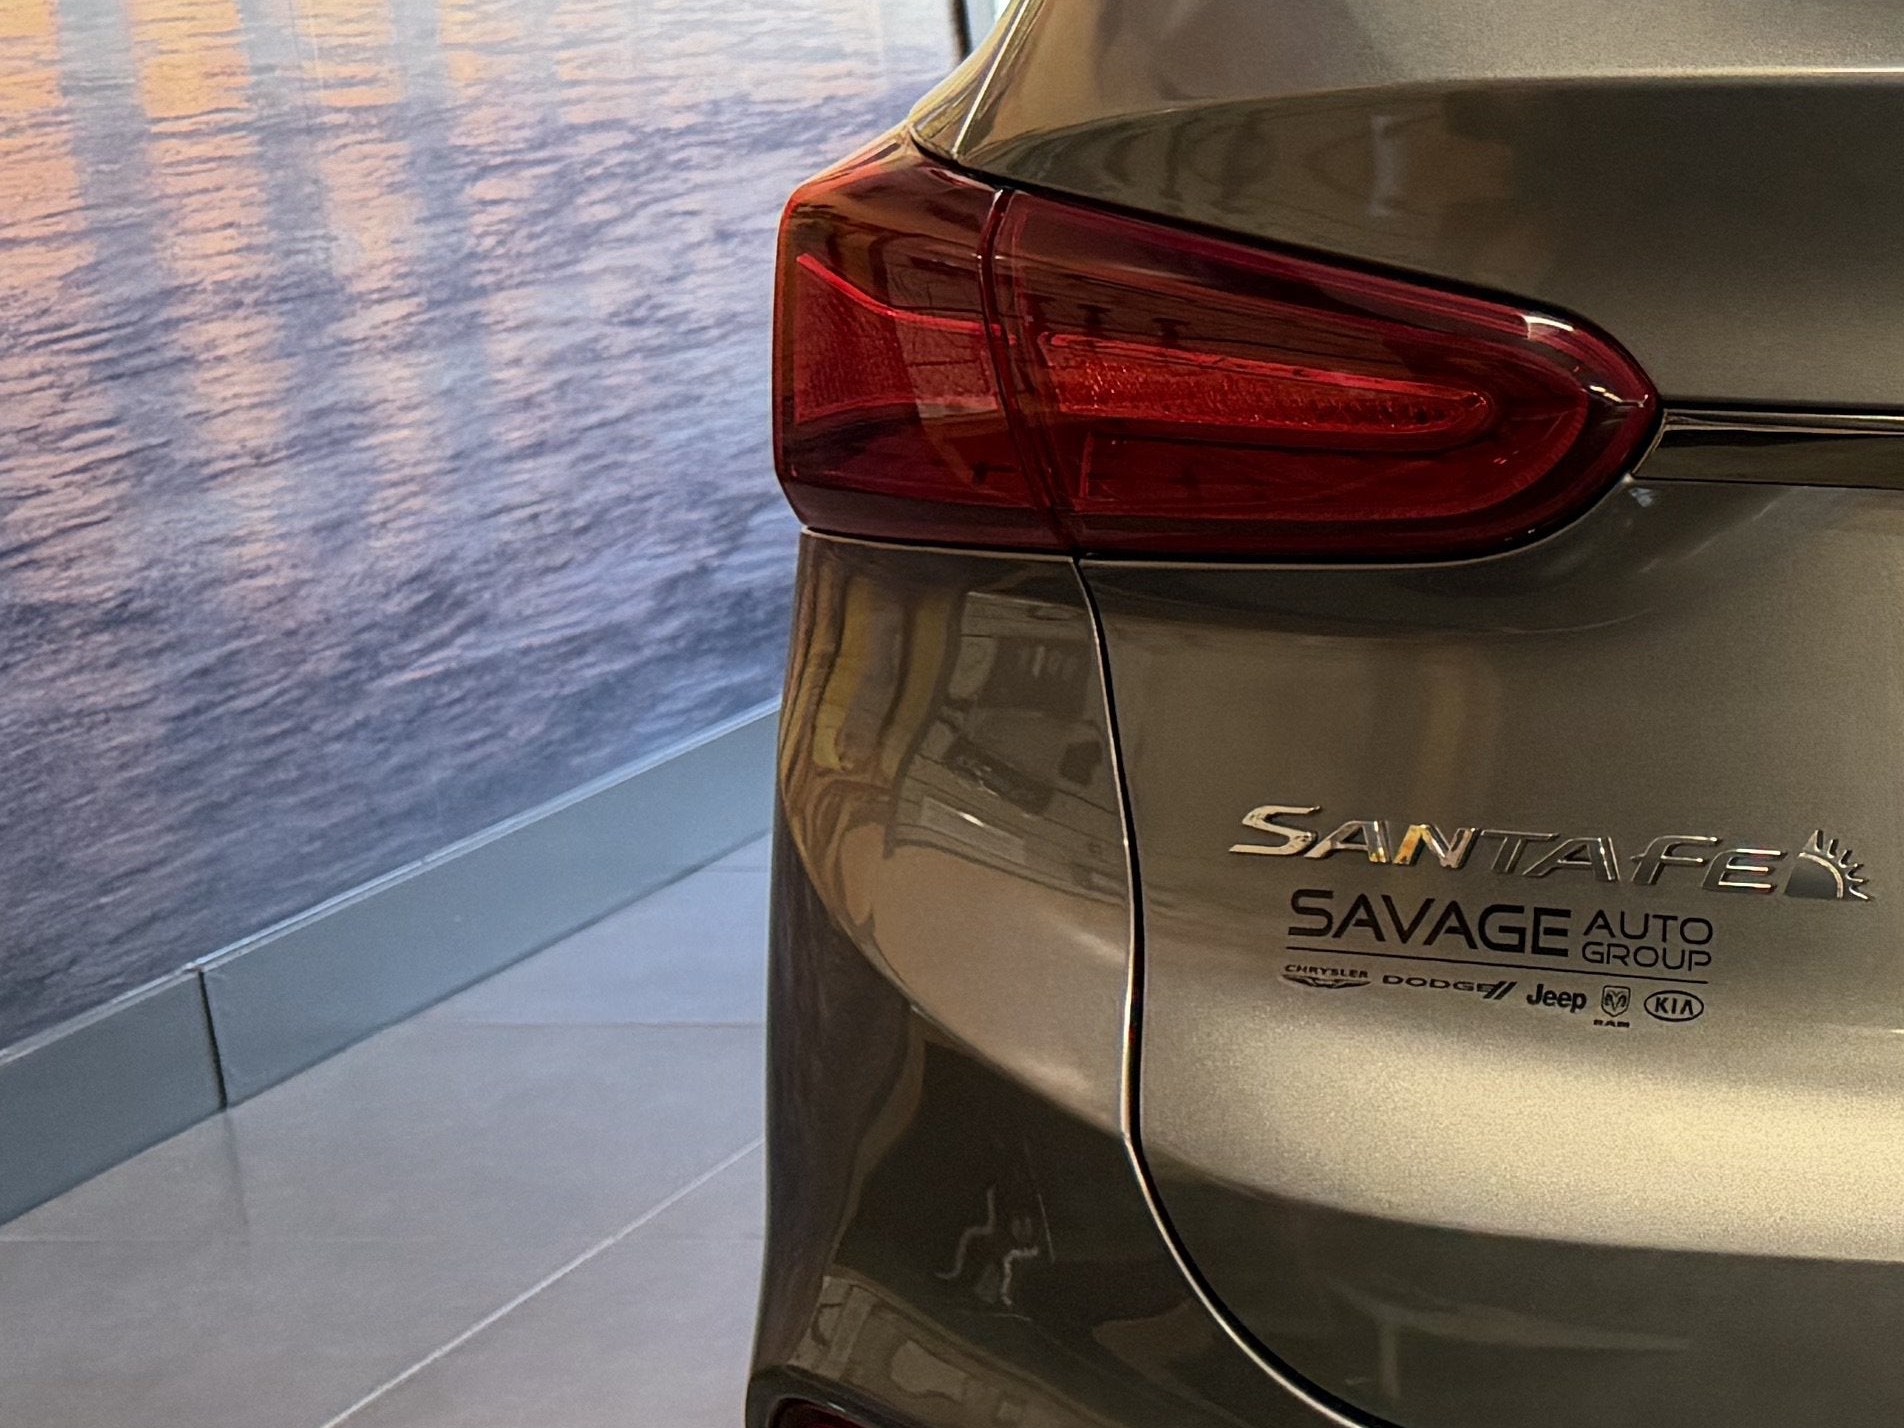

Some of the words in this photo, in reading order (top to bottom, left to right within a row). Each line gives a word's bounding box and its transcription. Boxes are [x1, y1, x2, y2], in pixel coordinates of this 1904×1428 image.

[1288, 888, 1572, 958] SAVAGE
[1583, 909, 1713, 945] AUTO
[1582, 941, 1712, 972] GROUP
[1284, 963, 1369, 979] CHRYSLER
[1382, 974, 1499, 993] DODGE
[1526, 983, 1587, 1013] Jeep
[1654, 996, 1694, 1016] KIA
